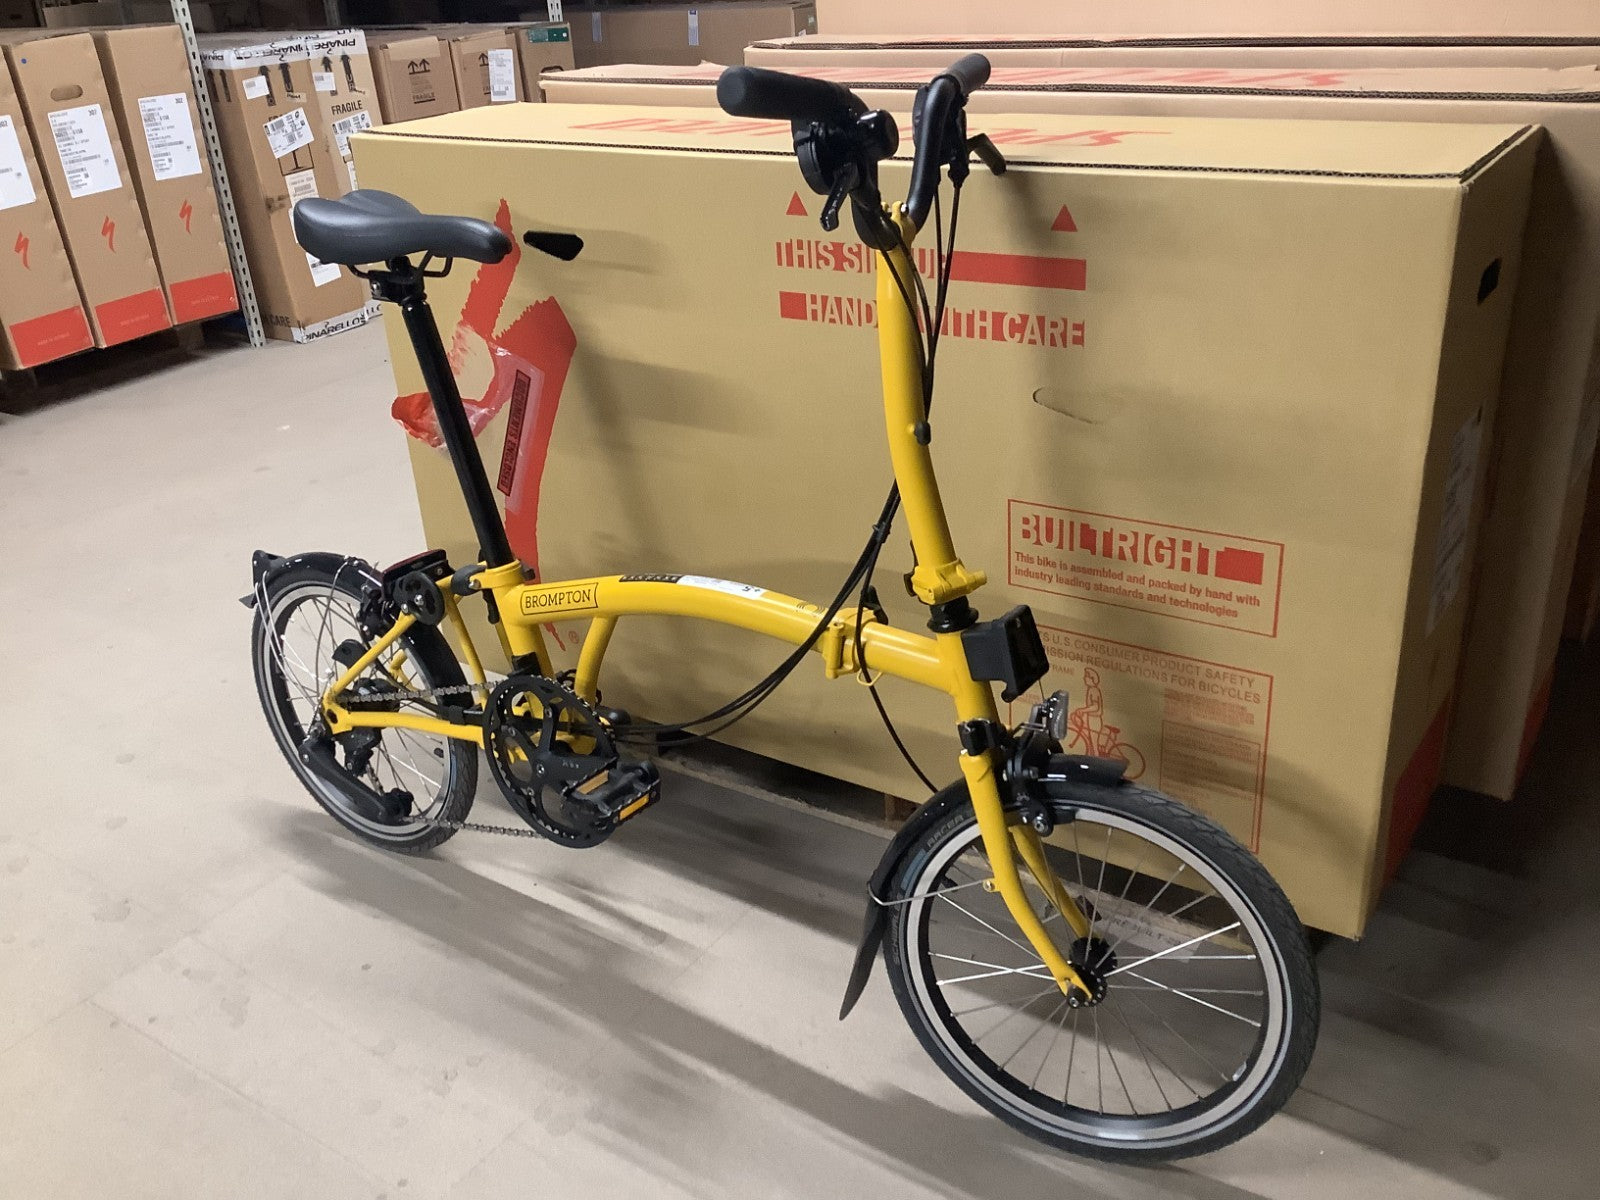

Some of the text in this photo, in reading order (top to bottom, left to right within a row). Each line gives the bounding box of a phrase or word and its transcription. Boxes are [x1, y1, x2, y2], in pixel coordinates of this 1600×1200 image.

[331, 101, 362, 115] FRAGILE
[775, 238, 835, 271] THIS
[1002, 311, 1085, 349] CARE
[1018, 513, 1226, 577] BUILTRIGHT
[525, 589, 591, 609] BROMPTON
[1015, 551, 1260, 607] This bike is assembled and packed by hand with
[1015, 566, 1238, 618] industry leading standards and technologies
[1046, 646, 1260, 704] ISSION REGULATIONS FOR BICYCLES
[1074, 639, 1140, 662] CONSUMER
[1142, 655, 1200, 676] PRODUCT
[1205, 668, 1255, 688] SAFETY
